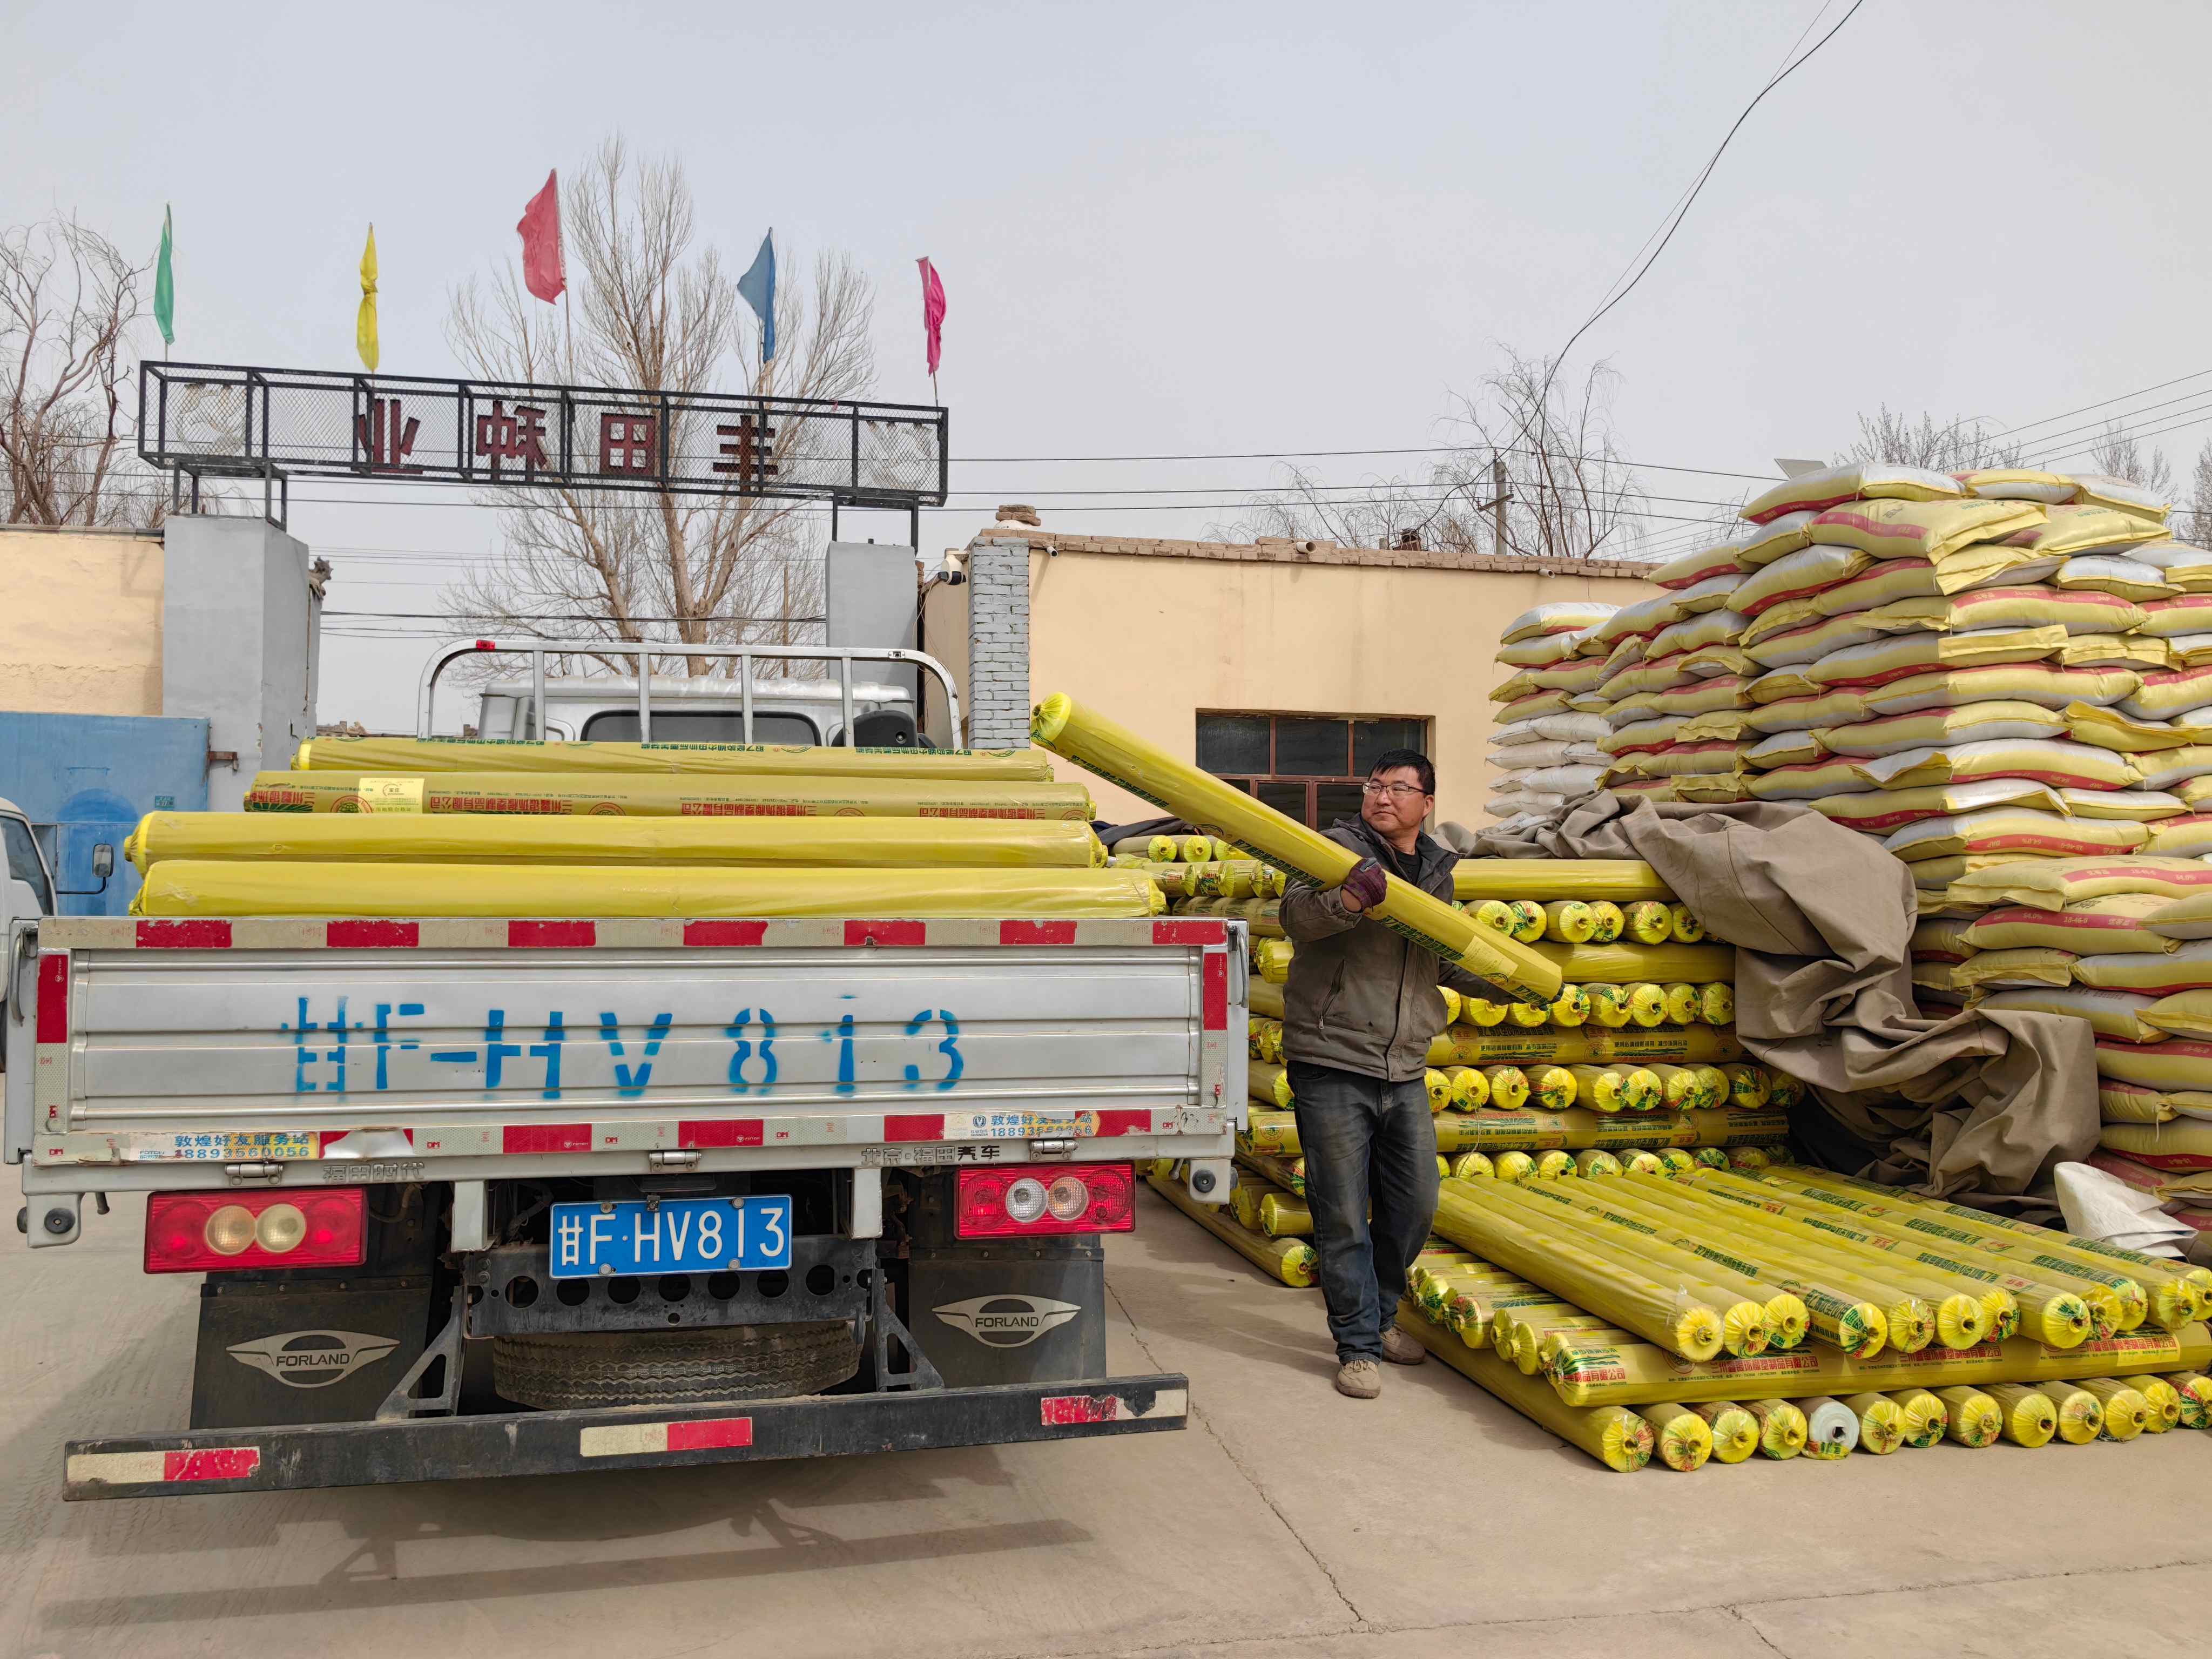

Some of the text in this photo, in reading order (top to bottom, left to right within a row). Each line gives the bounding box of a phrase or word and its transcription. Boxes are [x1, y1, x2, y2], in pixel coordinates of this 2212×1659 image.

[49, 1105, 57, 1118] DM
[174, 1135, 310, 1148] 敦煌好友服务站
[323, 1161, 425, 1181] 福田时代
[558, 1208, 785, 1266] 甘F·HV813
[974, 1314, 1041, 1328] FORLAND
[275, 1352, 351, 1368] FORLAND
